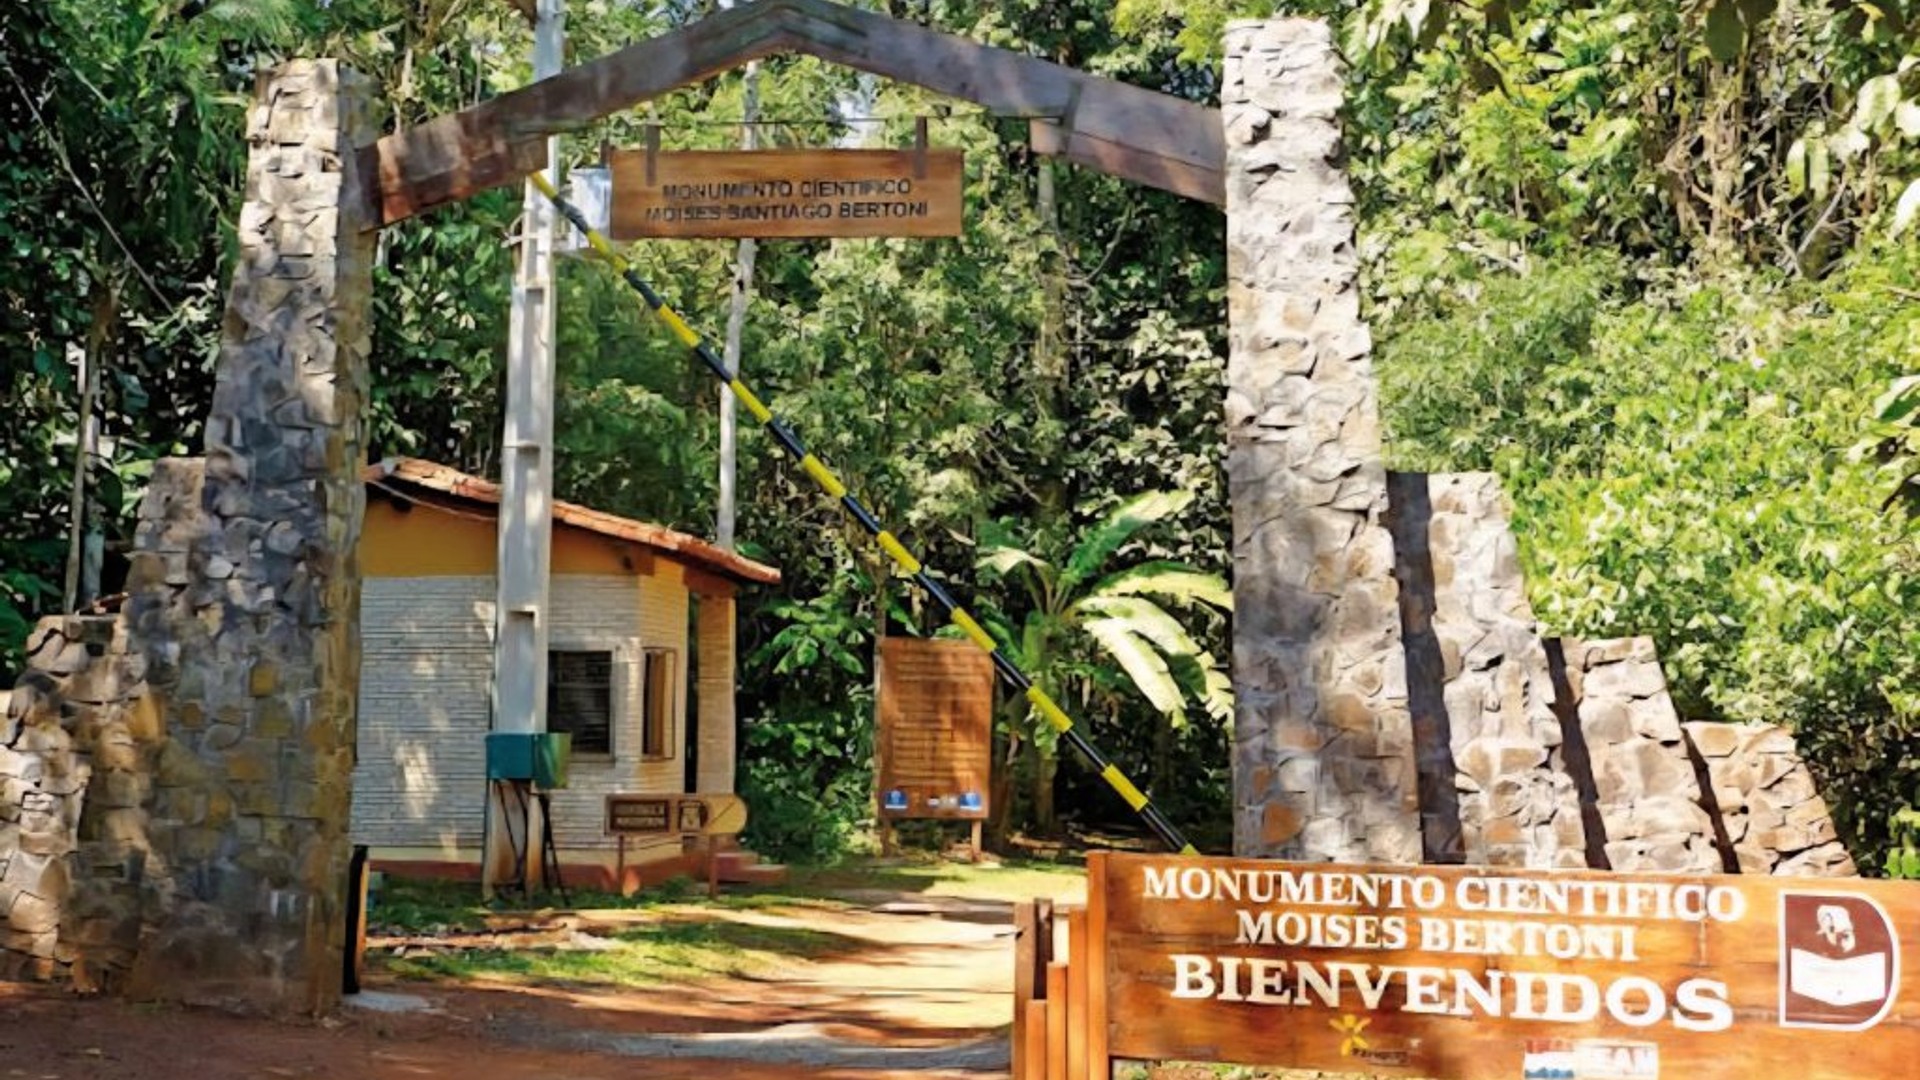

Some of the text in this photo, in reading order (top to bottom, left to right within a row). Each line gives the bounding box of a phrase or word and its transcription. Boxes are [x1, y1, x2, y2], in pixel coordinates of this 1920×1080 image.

[727, 203, 832, 220] SANTIAGO
[839, 201, 928, 219] BERTONI
[801, 178, 911, 198] CIENTICO
[1143, 867, 1746, 922] MONUMENTO CIENTIFICO
[1235, 909, 1638, 962] MOISES BERTONI
[1169, 954, 1733, 1031] BIENVENIDOS
